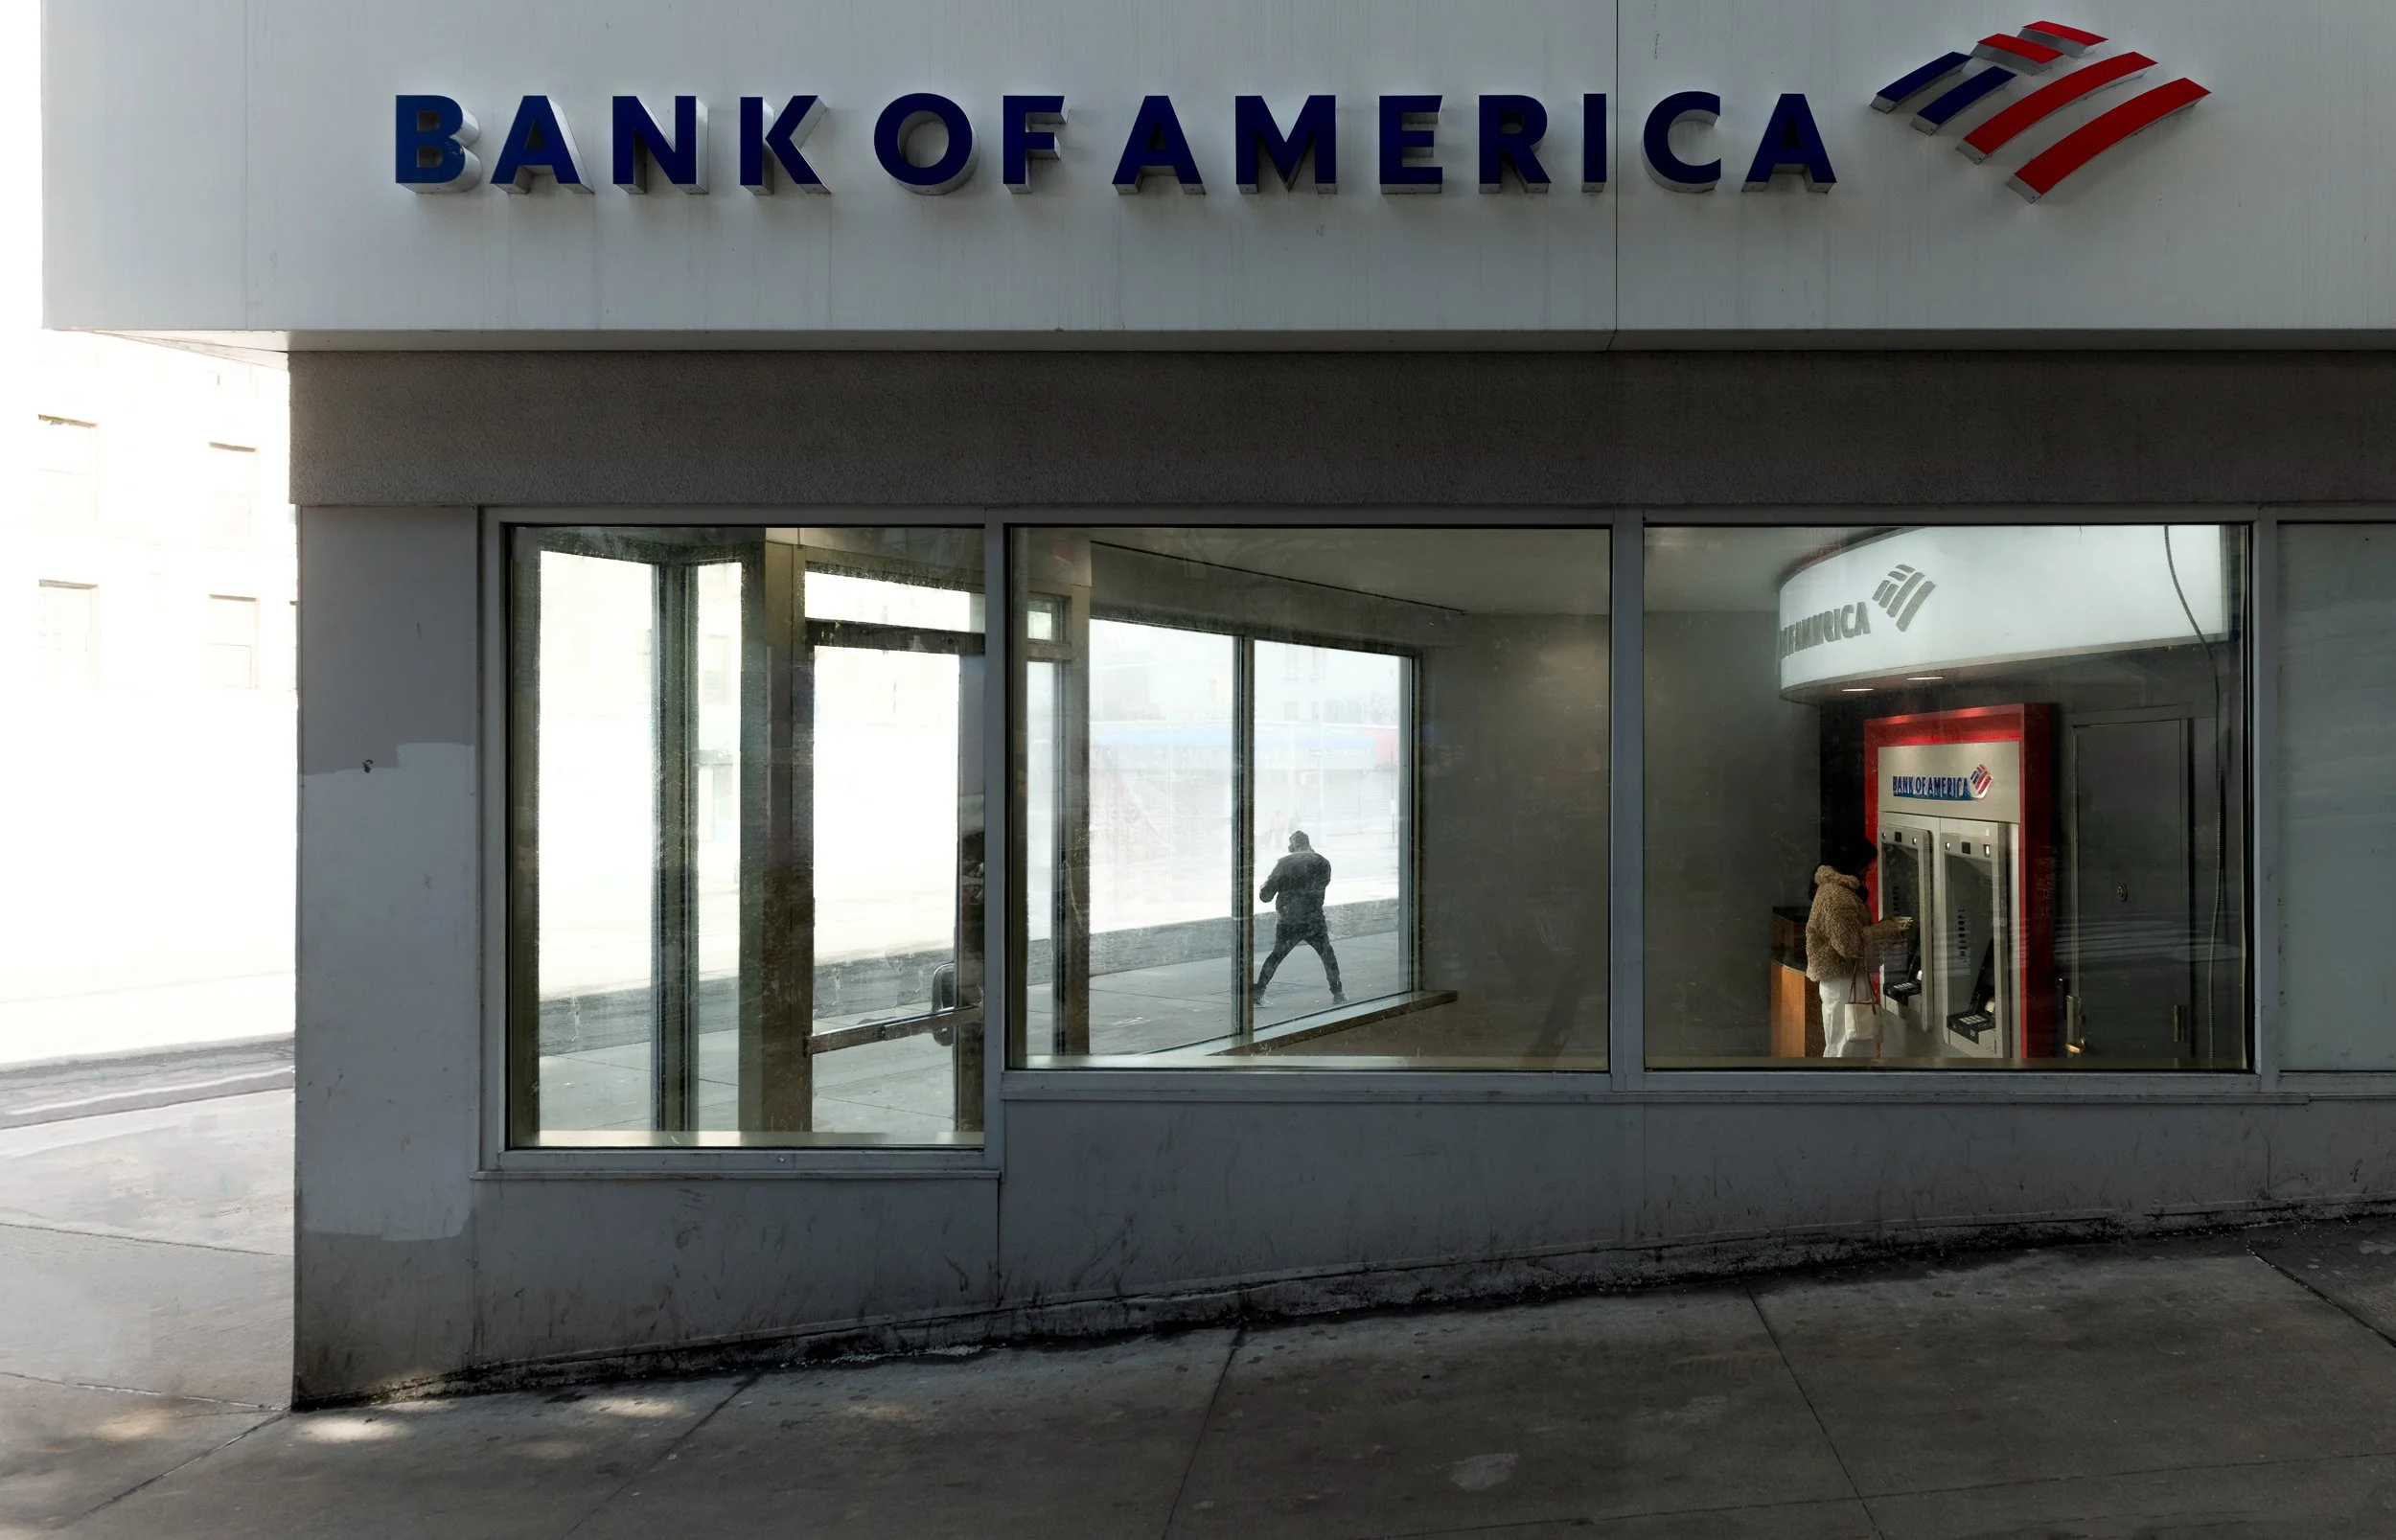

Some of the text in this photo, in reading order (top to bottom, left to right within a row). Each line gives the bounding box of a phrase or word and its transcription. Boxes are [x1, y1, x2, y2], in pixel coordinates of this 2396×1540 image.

[395, 91, 1838, 191] BANK OF AMERICA
[1892, 776, 1971, 799] BANK OF AMERICA
